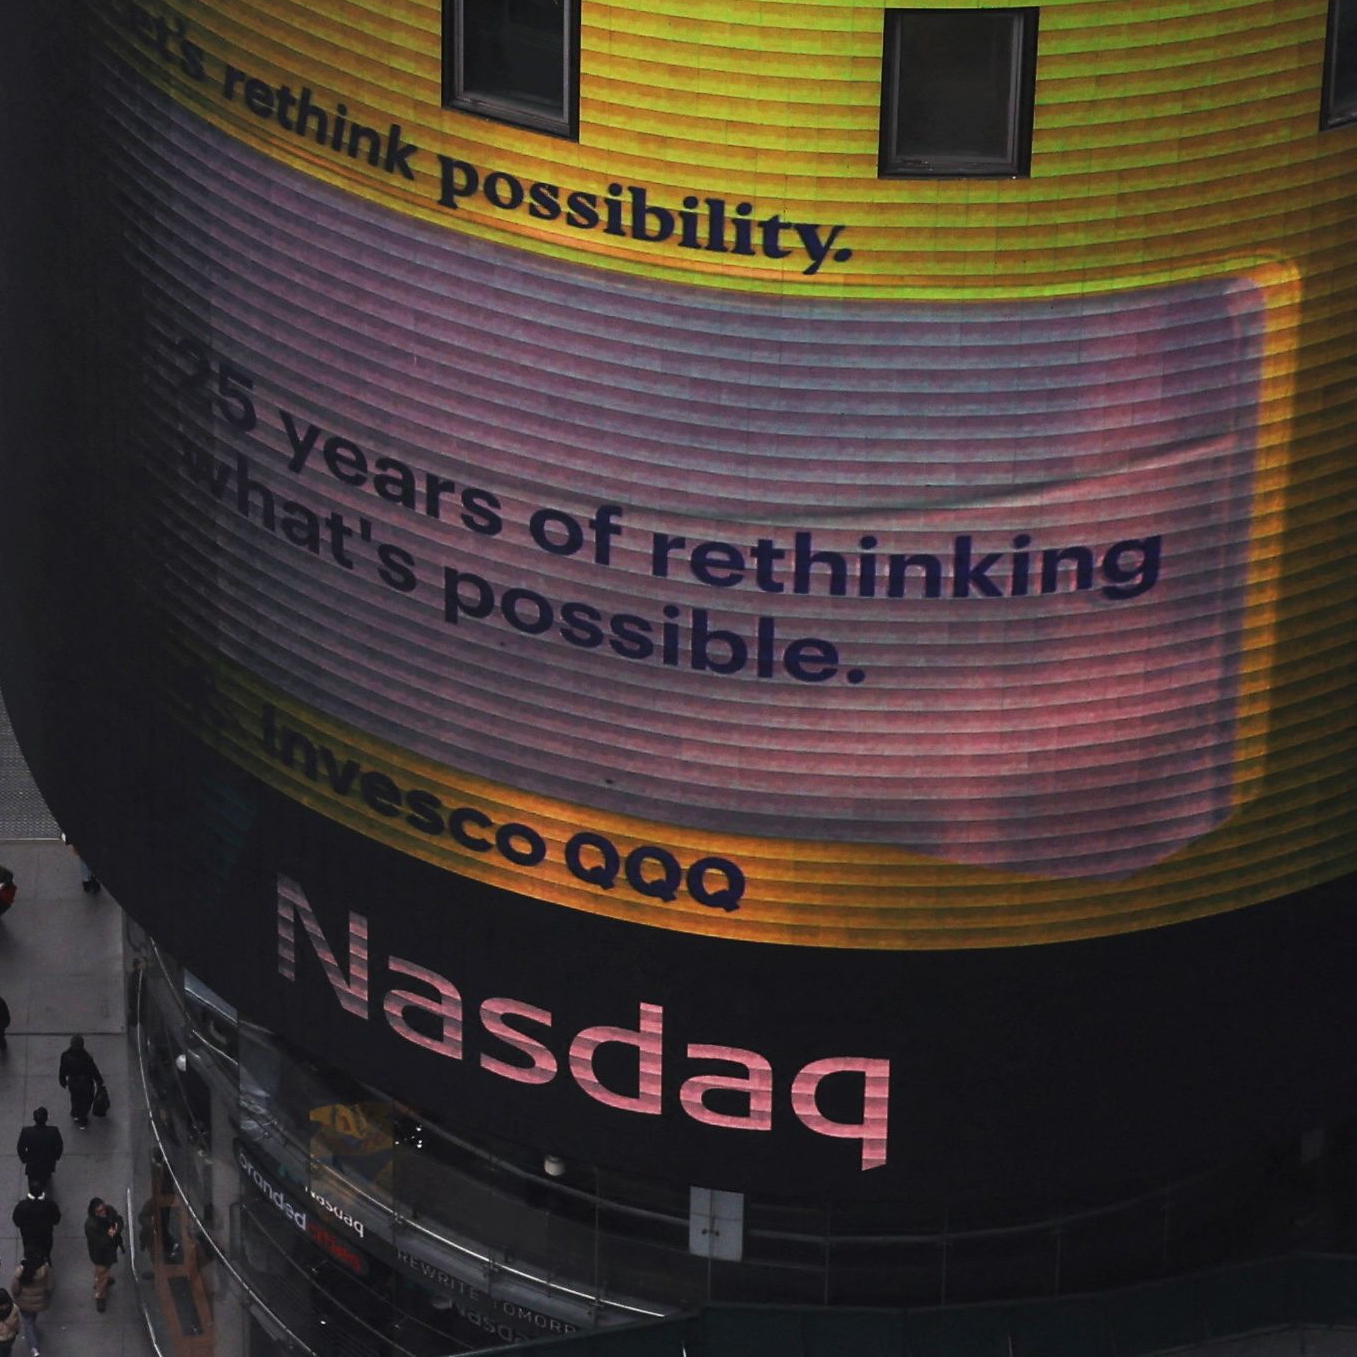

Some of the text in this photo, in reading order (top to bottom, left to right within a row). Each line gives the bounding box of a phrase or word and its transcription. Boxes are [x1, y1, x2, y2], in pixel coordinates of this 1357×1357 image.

[222, 63, 417, 181] rethink
[437, 153, 853, 275] possibility.
[183, 442, 867, 685] what's possible.
[279, 407, 504, 537] years
[528, 505, 622, 566] of
[650, 531, 1162, 600] rethinking
[260, 701, 747, 914] Invesco QQQ
[277, 872, 891, 1172] Nasdaq
[397, 1250, 480, 1300] REWRITE
